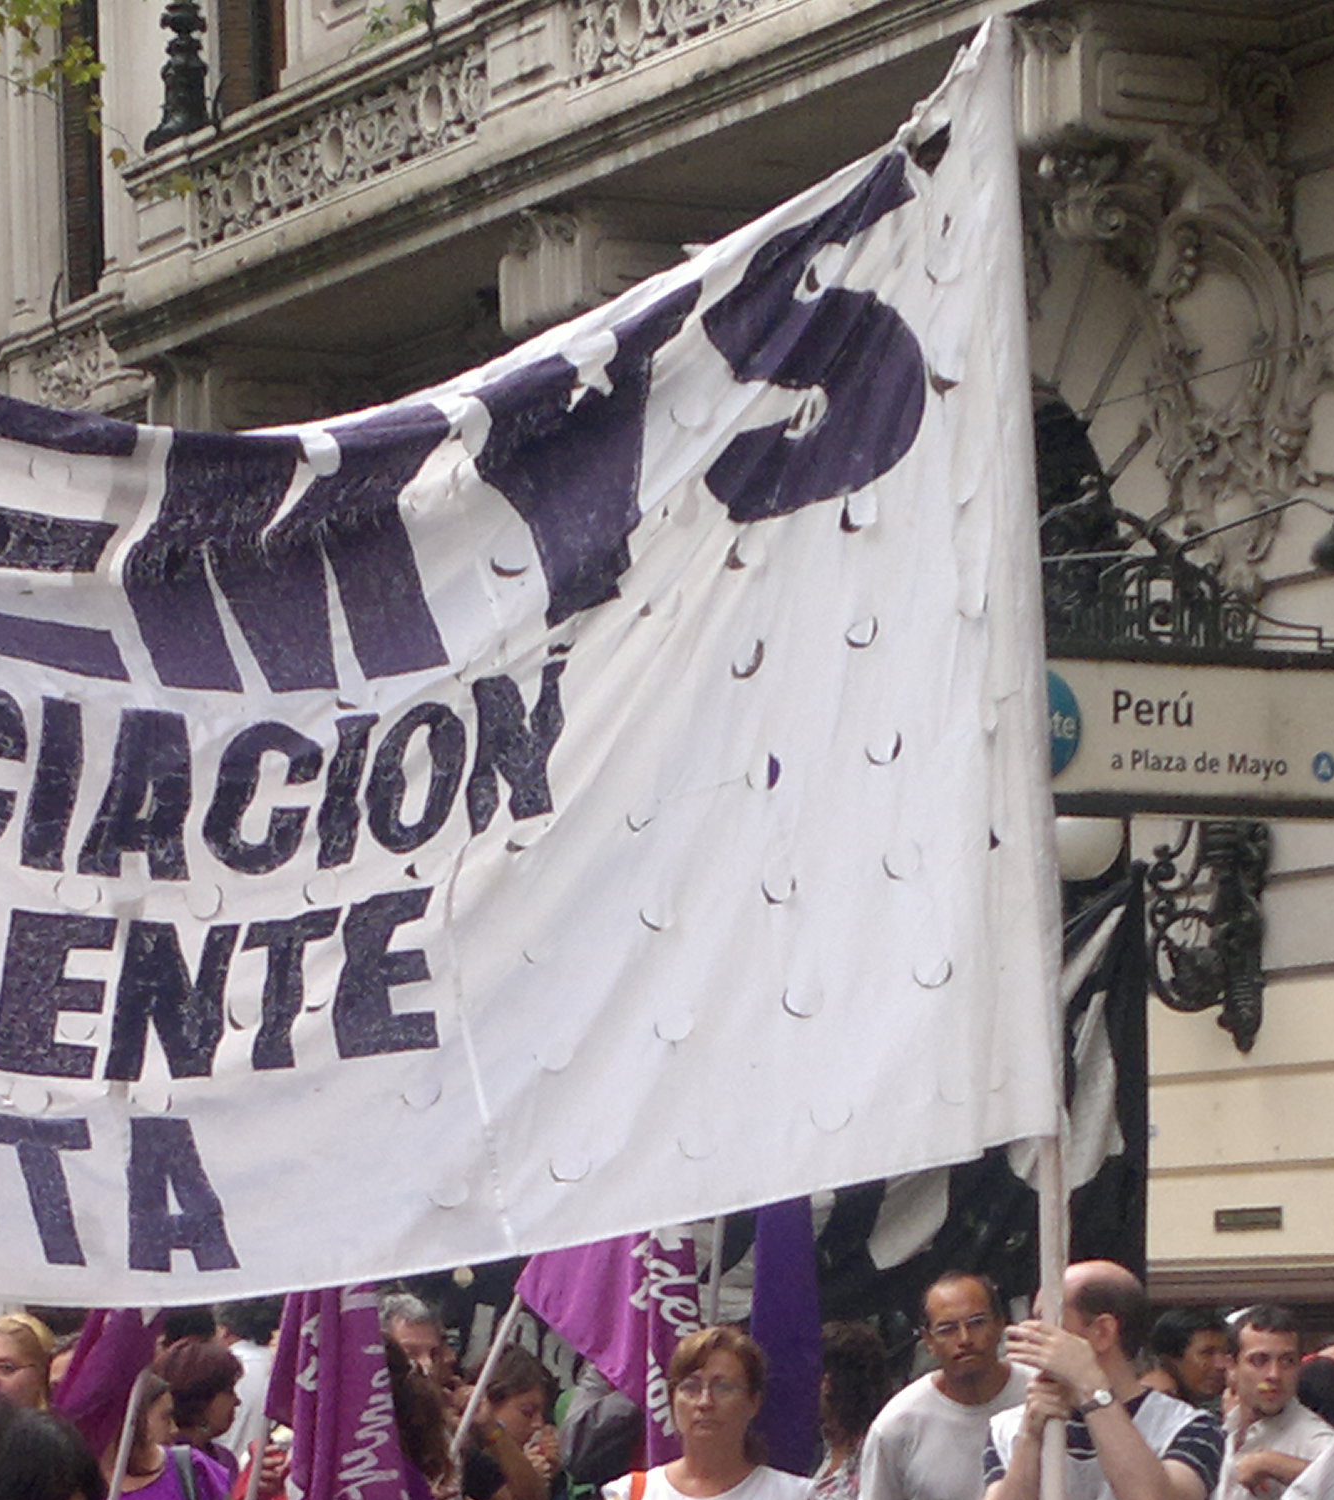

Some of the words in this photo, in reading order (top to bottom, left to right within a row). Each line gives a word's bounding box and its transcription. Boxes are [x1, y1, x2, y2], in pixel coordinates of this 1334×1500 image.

[1112, 690, 1193, 727] Perú
[1111, 753, 1123, 770] a
[1130, 749, 1188, 772] Plaza
[1193, 751, 1221, 774] de
[1227, 753, 1288, 781] Mayo
